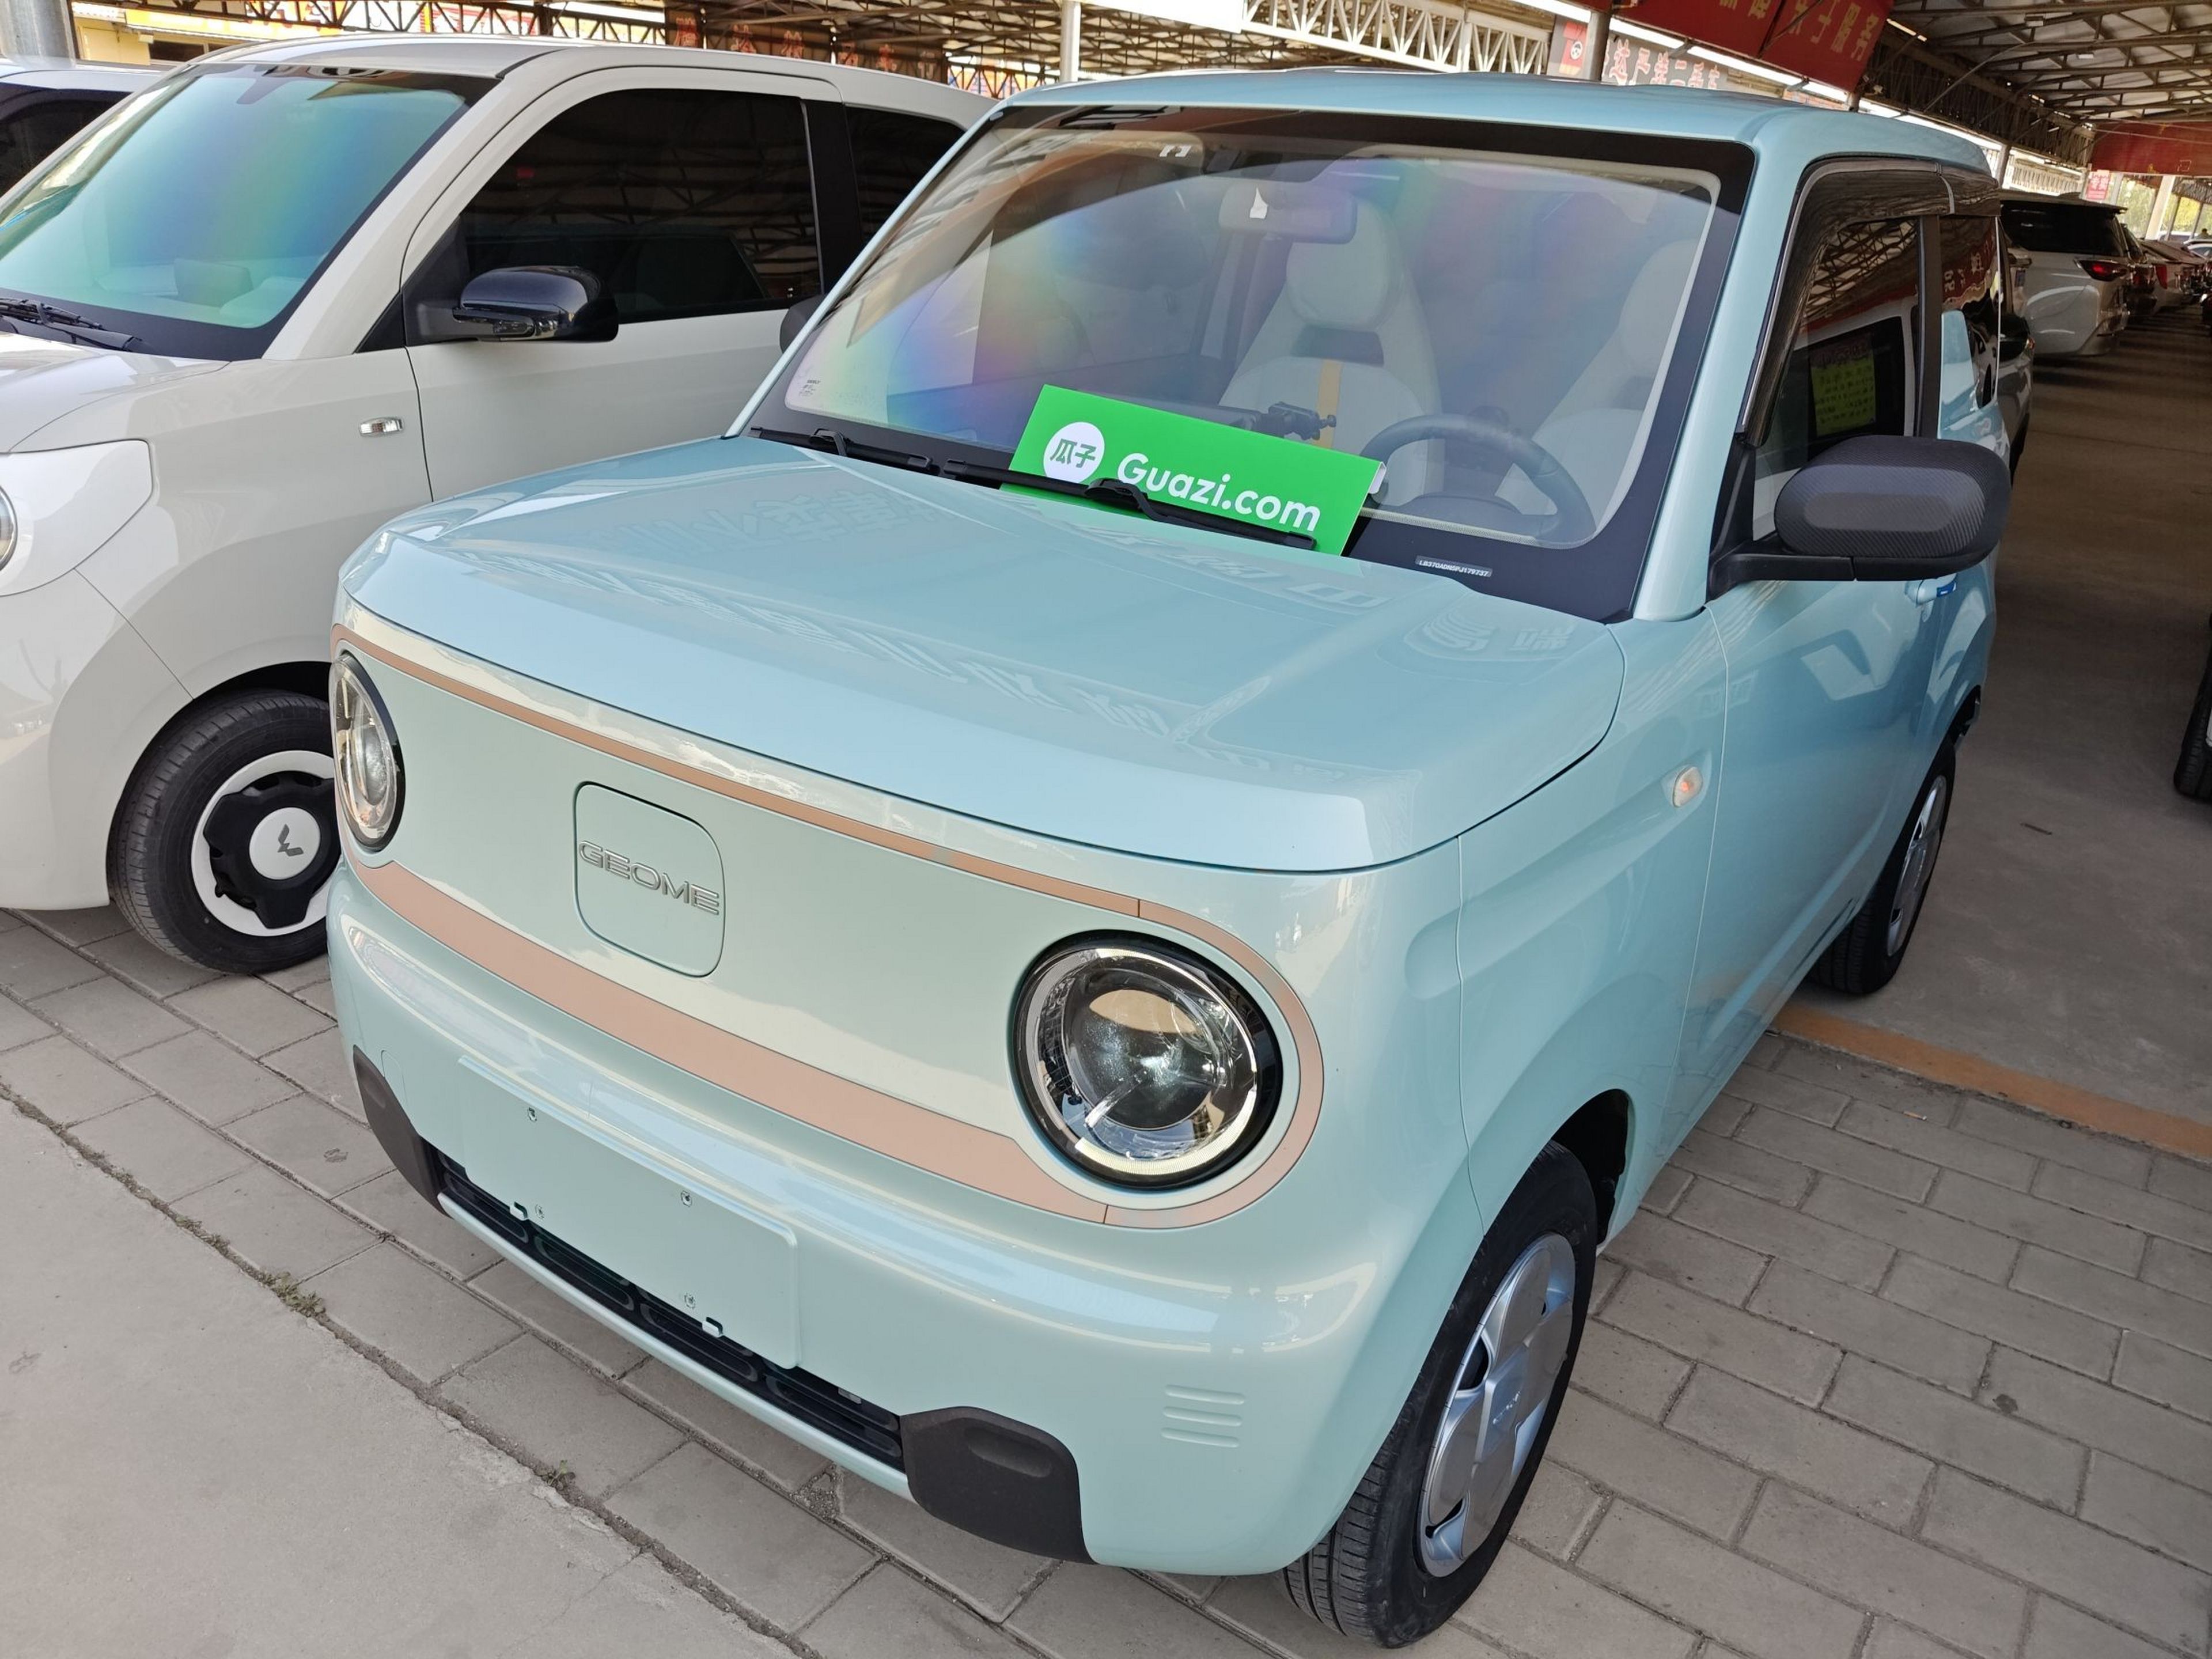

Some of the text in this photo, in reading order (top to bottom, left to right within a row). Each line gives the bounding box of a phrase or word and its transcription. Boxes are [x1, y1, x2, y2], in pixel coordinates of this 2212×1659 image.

[1050, 438, 1096, 468] 瓜子
[1117, 453, 1321, 531] Guazi.com
[578, 840, 719, 915] GEOME
